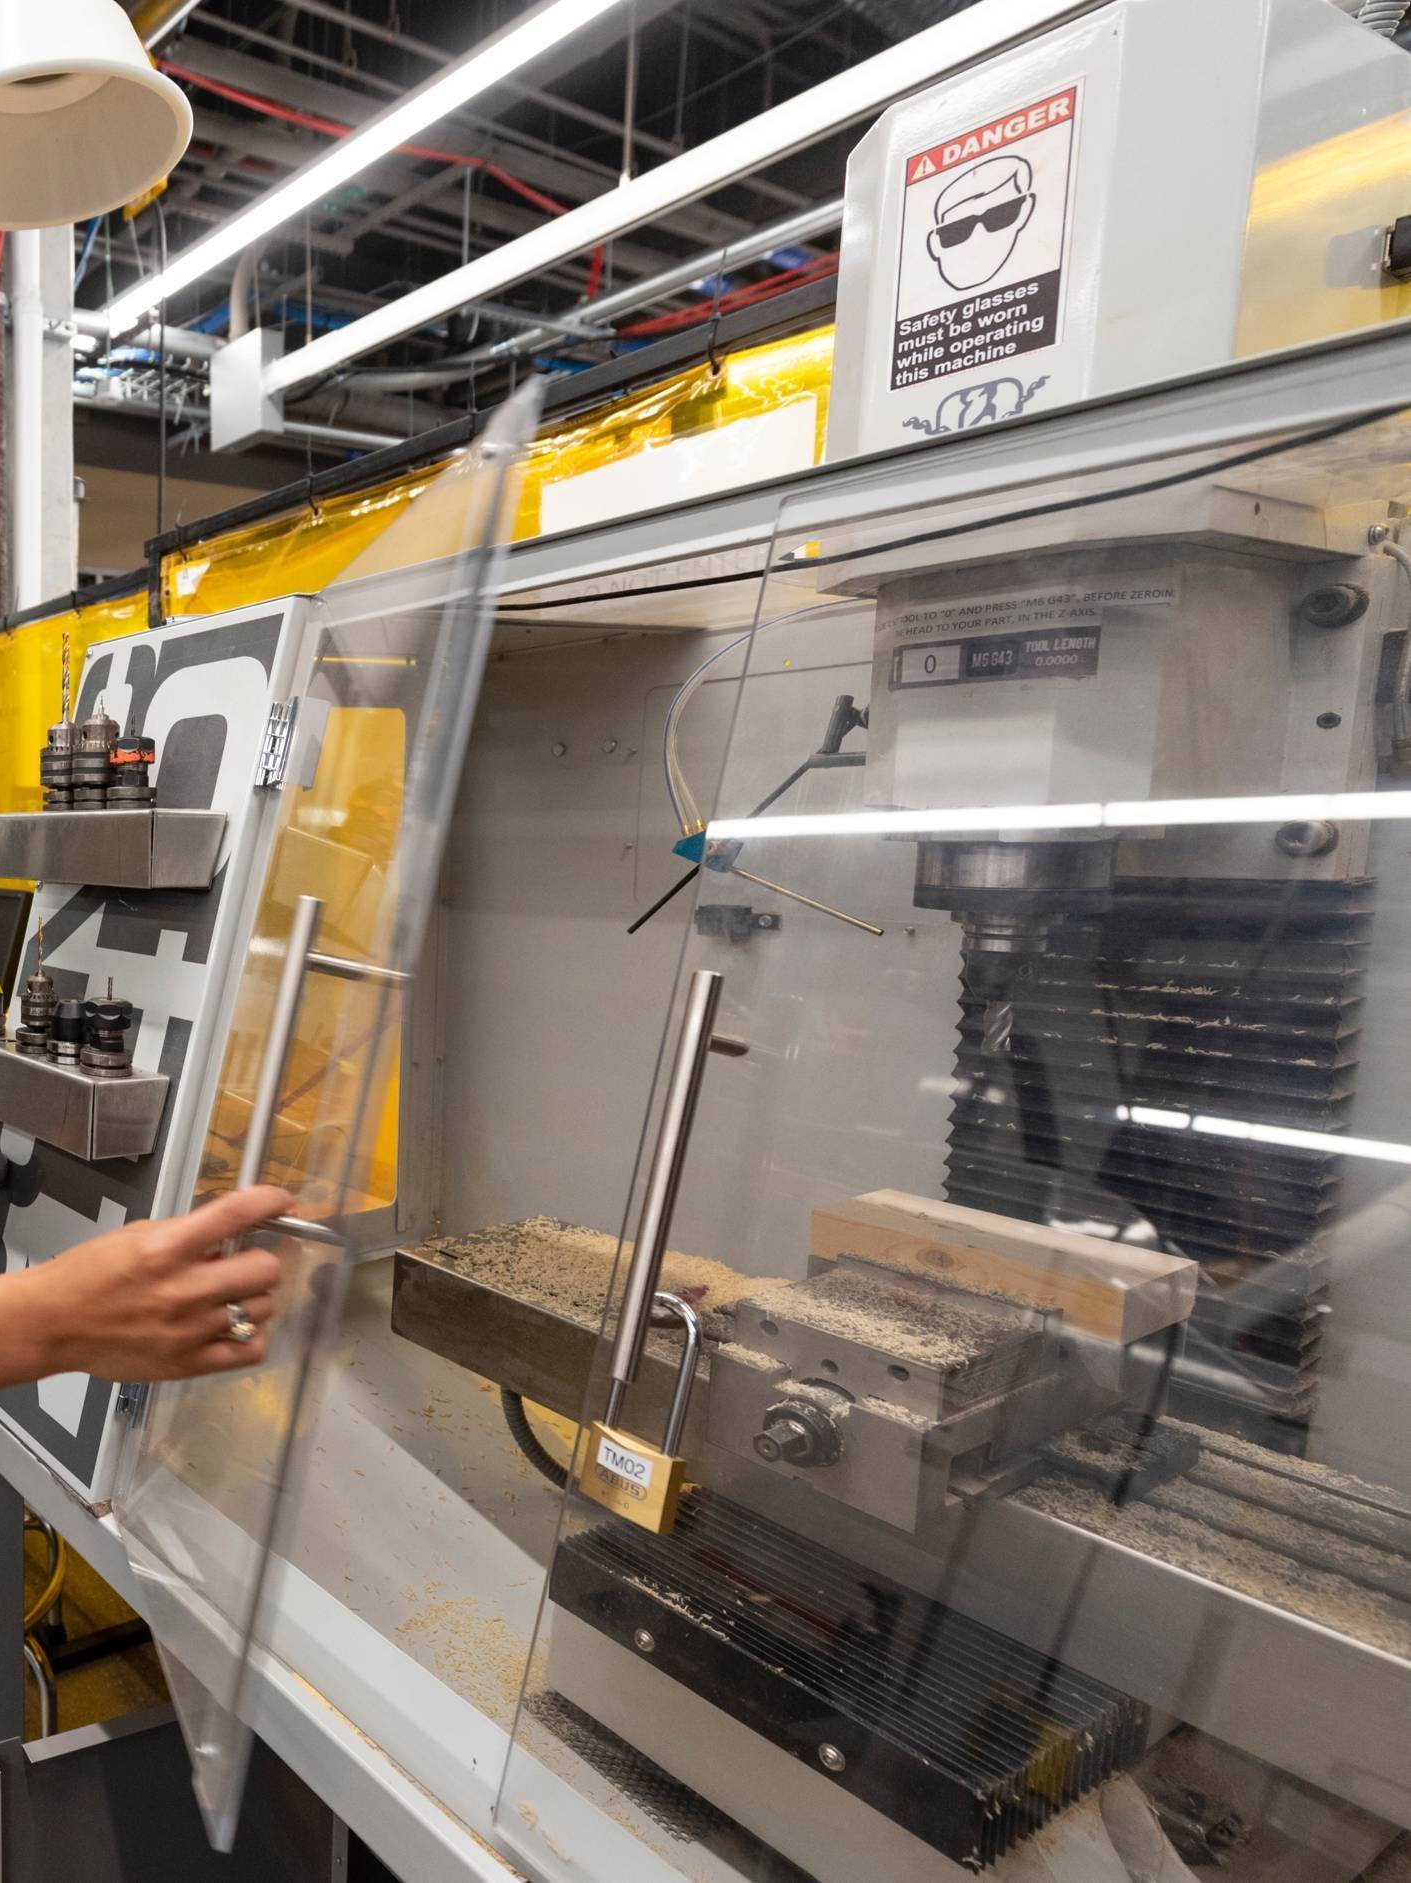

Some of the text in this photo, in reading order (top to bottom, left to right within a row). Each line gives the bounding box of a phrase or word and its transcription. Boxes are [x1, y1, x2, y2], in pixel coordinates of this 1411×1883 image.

[942, 96, 1070, 165] DANGER
[898, 281, 1039, 337] Safety glasses
[896, 314, 1045, 370] while operating
[897, 304, 1028, 353] must be worn
[895, 340, 1017, 387] this machine
[923, 609, 937, 621] TO
[958, 604, 983, 617] AND
[985, 600, 1018, 613] PRESS
[1083, 590, 1128, 602] BEFORE
[904, 625, 933, 637] HEAD
[935, 622, 950, 634] TO
[951, 618, 982, 632] YOUR
[1018, 612, 1031, 623] IN
[1033, 610, 1056, 622] THE
[1025, 636, 1097, 654] TOOL LENGTH
[1034, 654, 1079, 667] 0.0000
[924, 654, 937, 674] 0
[972, 652, 988, 668] M6
[604, 1445, 646, 1480] TM02
